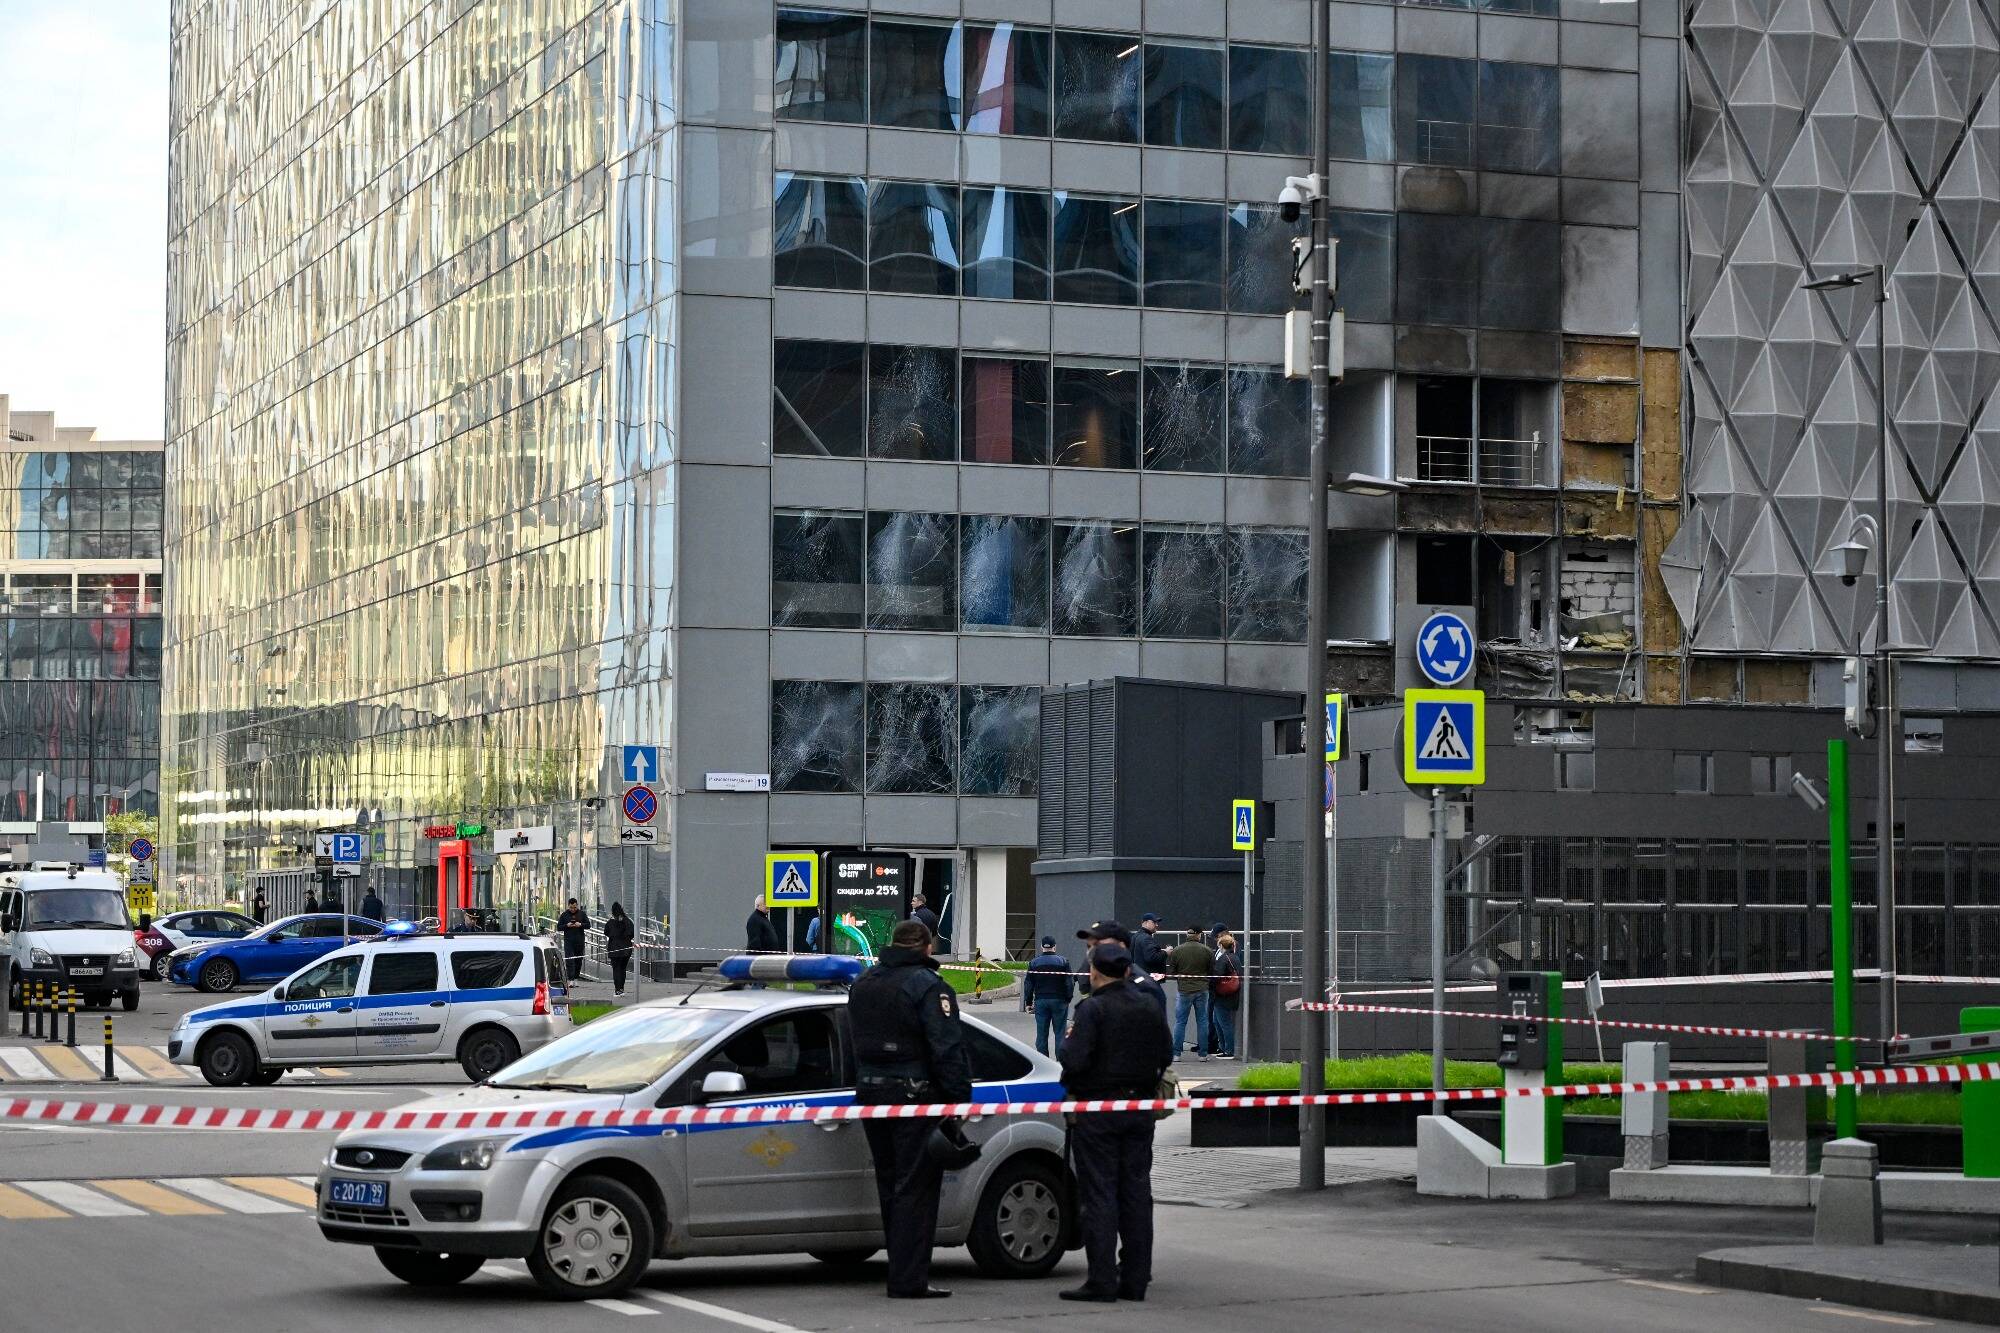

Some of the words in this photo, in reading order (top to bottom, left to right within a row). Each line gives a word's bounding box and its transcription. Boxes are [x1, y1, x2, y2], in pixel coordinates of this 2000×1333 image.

[757, 778, 768, 788] 19
[339, 836, 355, 858] P
[847, 863, 867, 871] SYDNEY
[847, 870, 858, 878] CITY
[865, 888, 874, 896] до
[876, 885, 899, 895] 25%
[144, 938, 162, 946] 308
[284, 1001, 332, 1012] ПОЛИЦИЯ
[342, 1183, 366, 1201] 2017
[371, 1183, 383, 1198] 99
